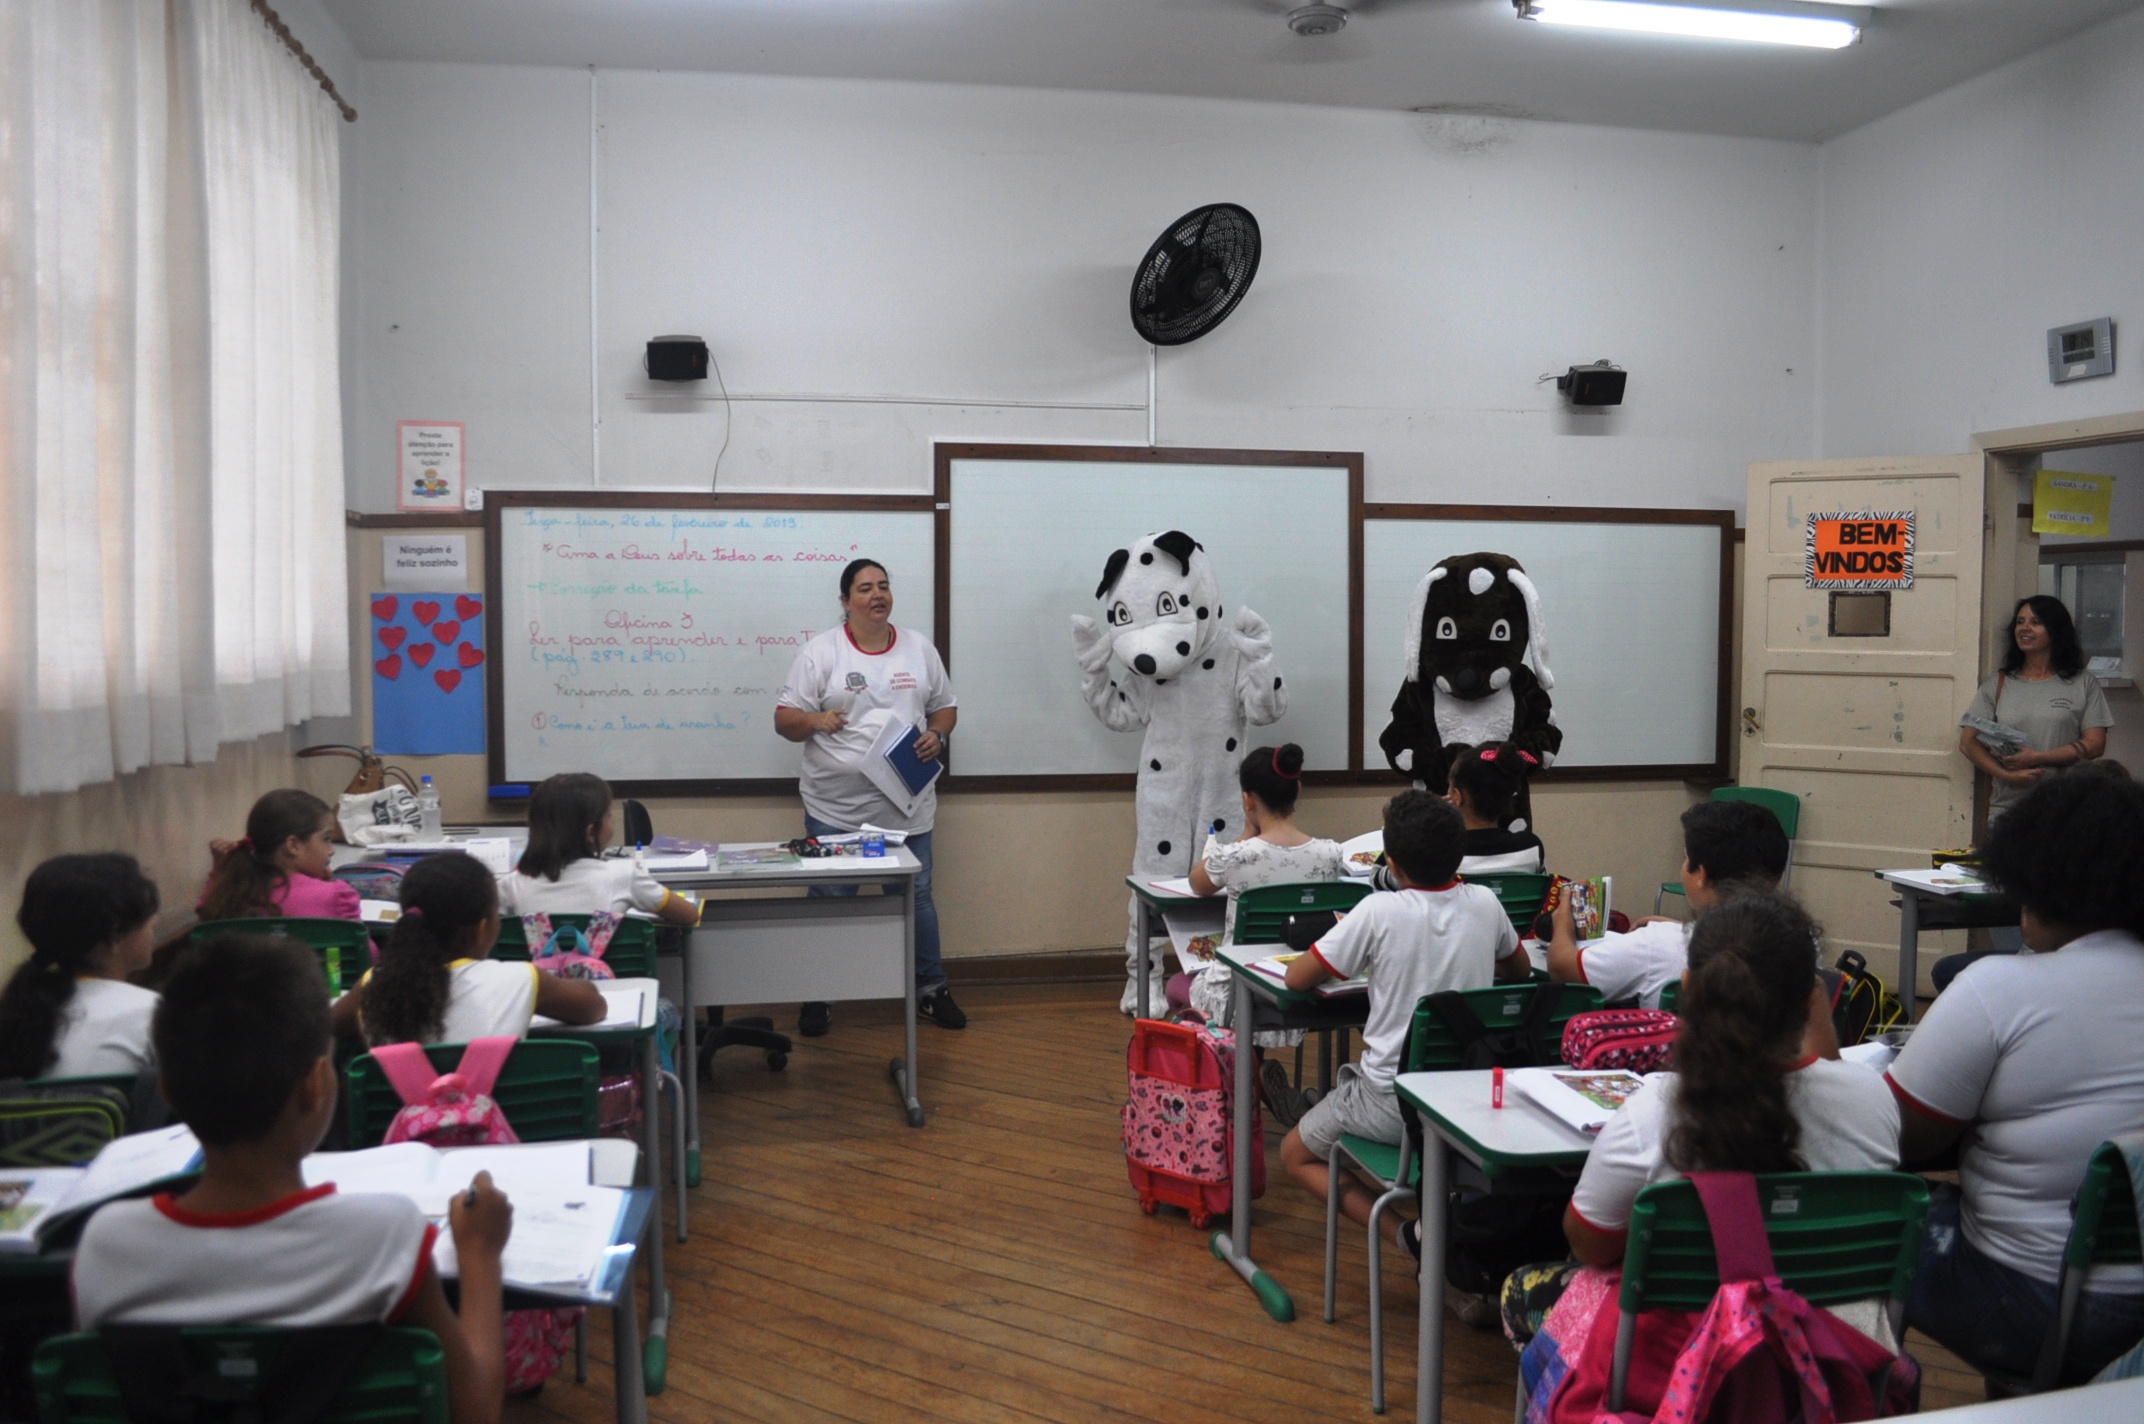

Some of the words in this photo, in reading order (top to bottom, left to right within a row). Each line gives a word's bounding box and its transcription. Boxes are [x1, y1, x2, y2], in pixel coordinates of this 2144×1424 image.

[620, 513, 641, 528] 26
[645, 514, 664, 528] de
[736, 516, 751, 528] de
[1839, 522, 1905, 545] BEM-
[399, 545, 444, 557] Ninguém
[445, 545, 452, 555] é
[605, 552, 615, 560] a
[622, 544, 660, 560] Deus
[667, 538, 706, 561] sobre
[712, 547, 756, 562] todas
[762, 553, 783, 562] as
[396, 558, 417, 568] feliz
[419, 558, 458, 568] sozinho
[1814, 551, 1904, 573] VINDOS
[604, 609, 672, 637] Oficina
[529, 621, 559, 646] Ler
[568, 635, 620, 656] para
[632, 632, 728, 656] aprender
[736, 637, 747, 646] e
[755, 635, 800, 656] para
[591, 650, 624, 662] 289
[554, 674, 633, 708] Responda
[643, 682, 659, 696] de
[665, 681, 721, 696] acordo
[733, 686, 767, 696] com
[549, 714, 583, 729] Como
[603, 722, 616, 730] a
[655, 717, 675, 730] de
[680, 712, 736, 730] aranha
